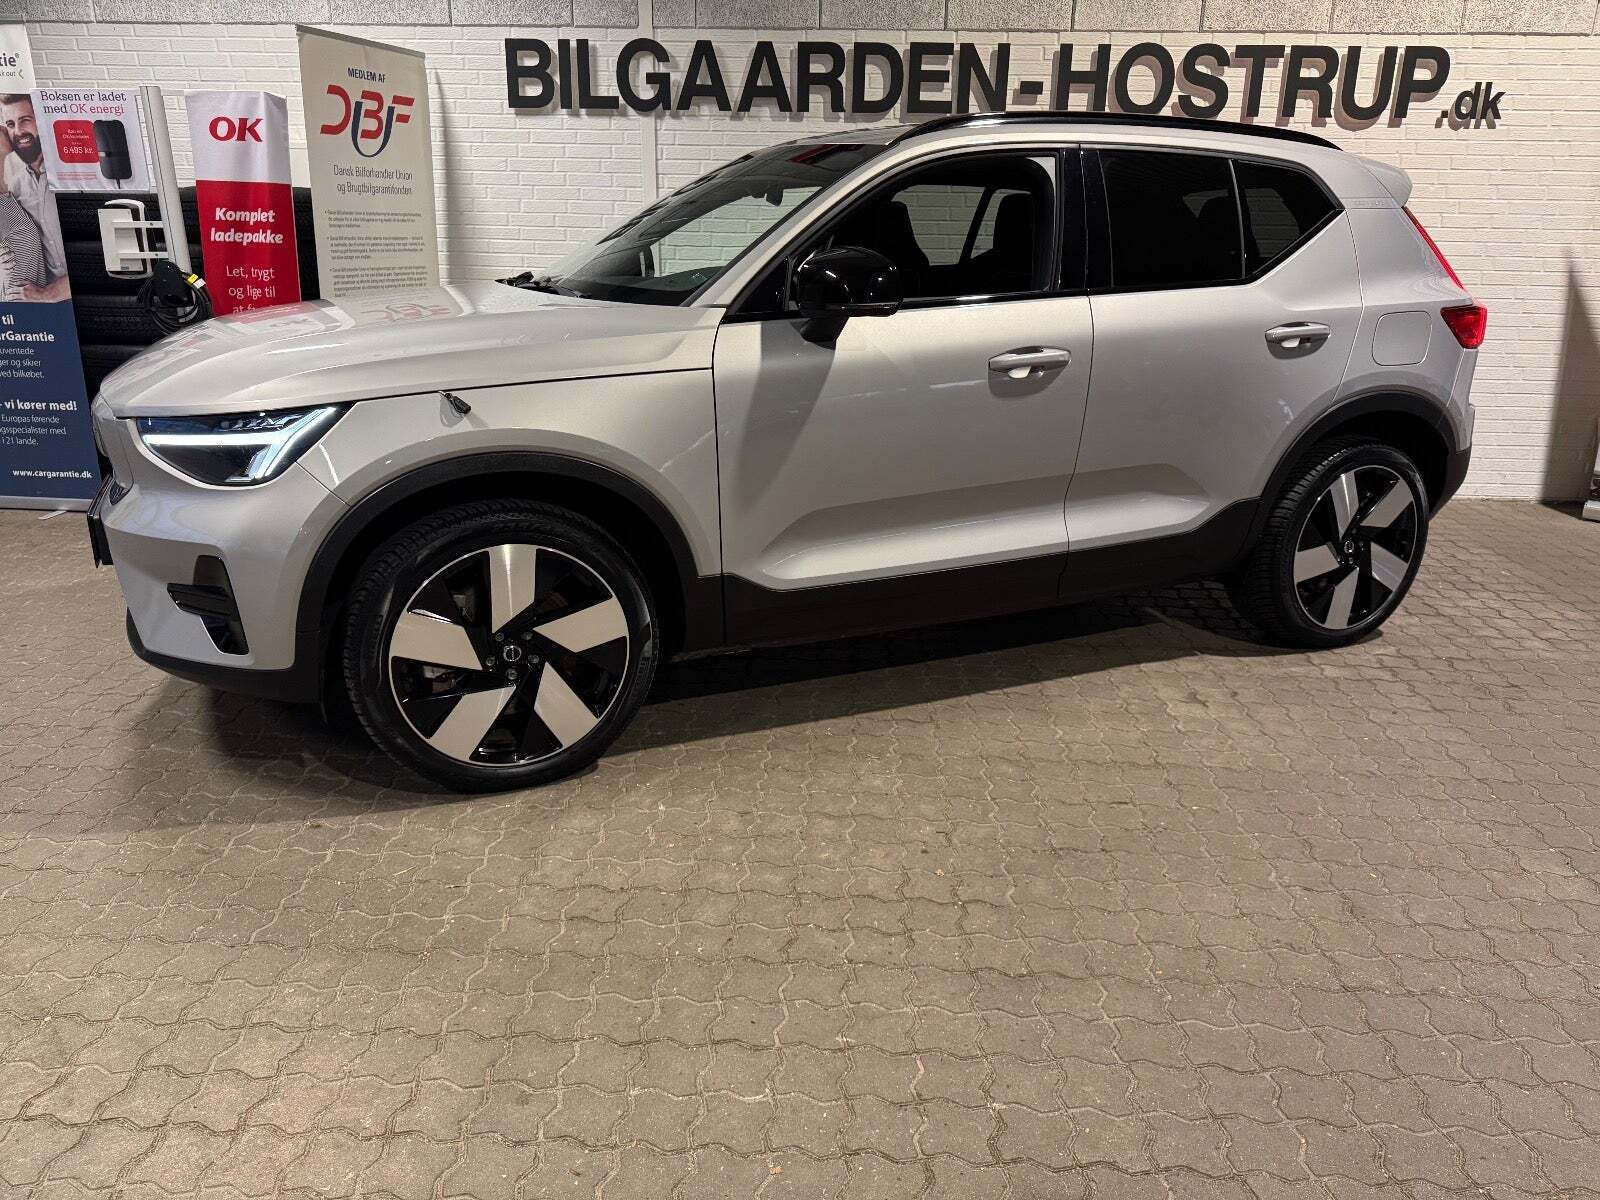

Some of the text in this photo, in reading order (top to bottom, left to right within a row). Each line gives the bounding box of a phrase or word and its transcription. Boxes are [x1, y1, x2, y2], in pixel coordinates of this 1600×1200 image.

[348, 67, 387, 83] MEDLEM AF
[40, 91, 127, 102] Boksen er ladet
[43, 104, 125, 116] med OK energi
[208, 116, 264, 143] OK
[333, 164, 413, 181] Dansk Bilforhandler Union
[337, 183, 346, 195] og
[215, 207, 276, 226] Komplet
[210, 227, 284, 246] ladepakke
[226, 265, 275, 282] Let, trygt
[228, 284, 276, 300] og lige til
[2, 314, 15, 325] til
[0, 331, 55, 342] rGarantie
[10, 360, 20, 368] og
[4, 399, 77, 411] vi kører med!
[1, 414, 60, 424] Europas førende
[50, 426, 67, 435] med
[6, 436, 14, 445] 21
[16, 436, 39, 445] lande.
[12, 469, 93, 479] www.cargarantie.dk
